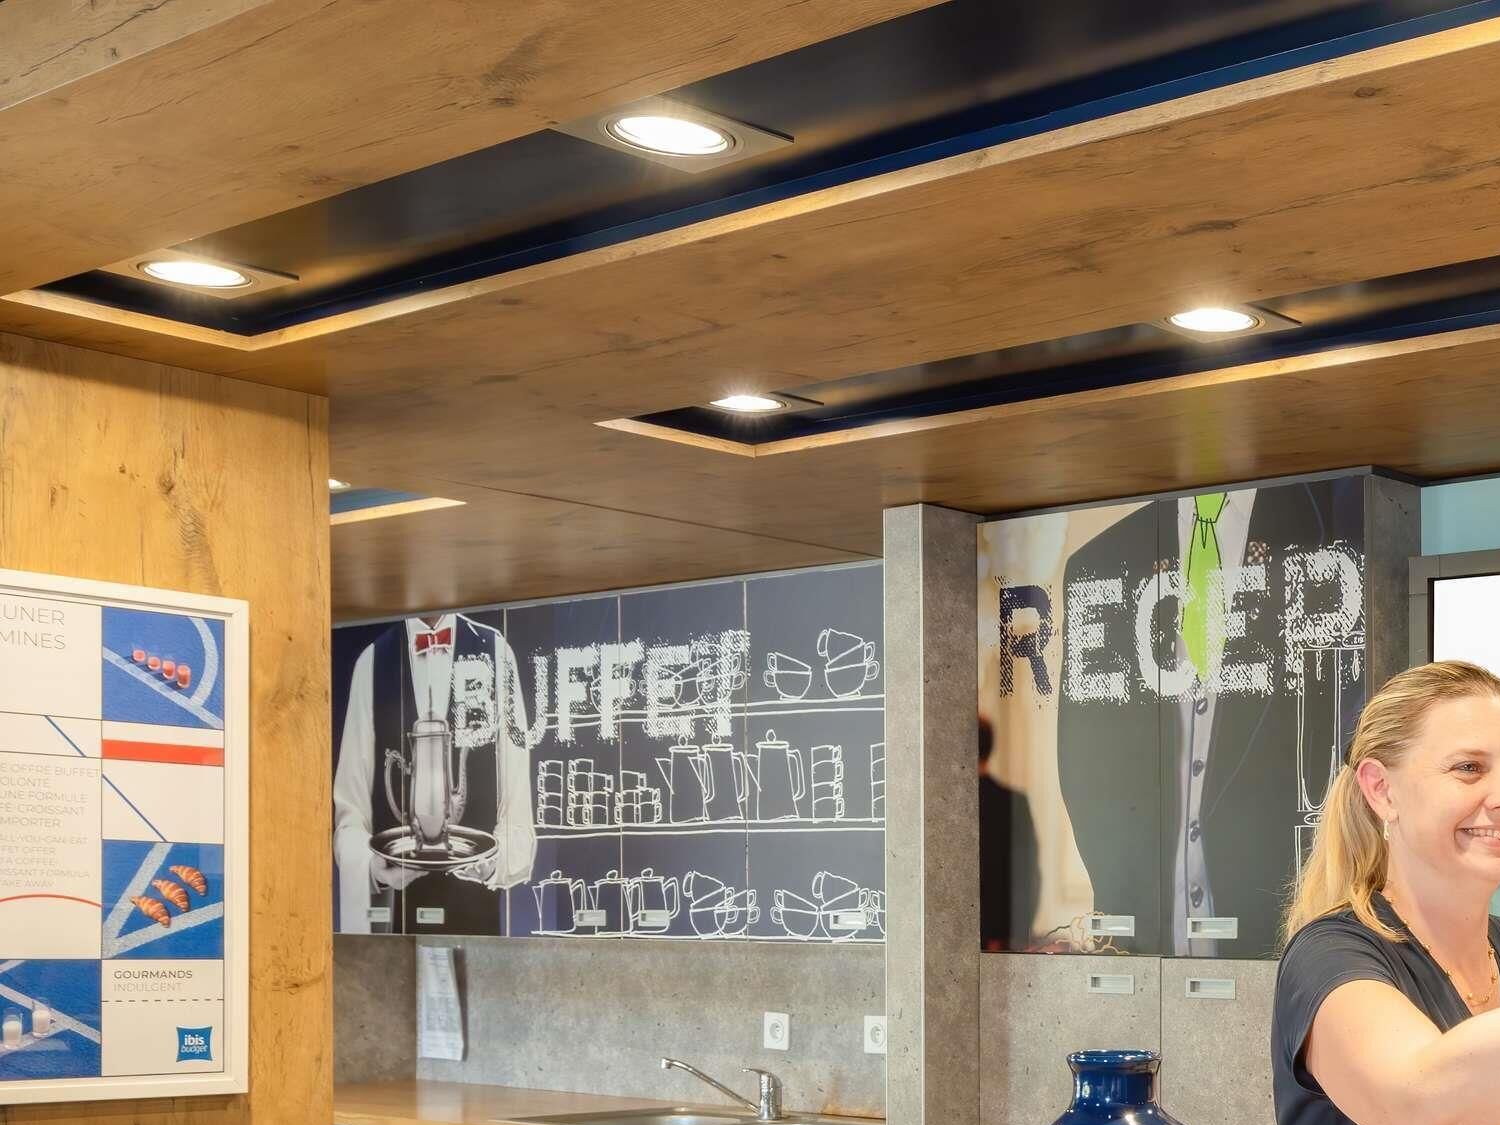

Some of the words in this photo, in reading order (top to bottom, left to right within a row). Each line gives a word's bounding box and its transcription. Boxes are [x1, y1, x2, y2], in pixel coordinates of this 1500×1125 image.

[0, 603, 65, 626] UNER
[450, 630, 750, 750] BUFFET
[114, 970, 193, 980] GOURMANDS
[114, 982, 182, 992] INDULGENT
[184, 1035, 204, 1046] ibis
[181, 1044, 208, 1055] budget
